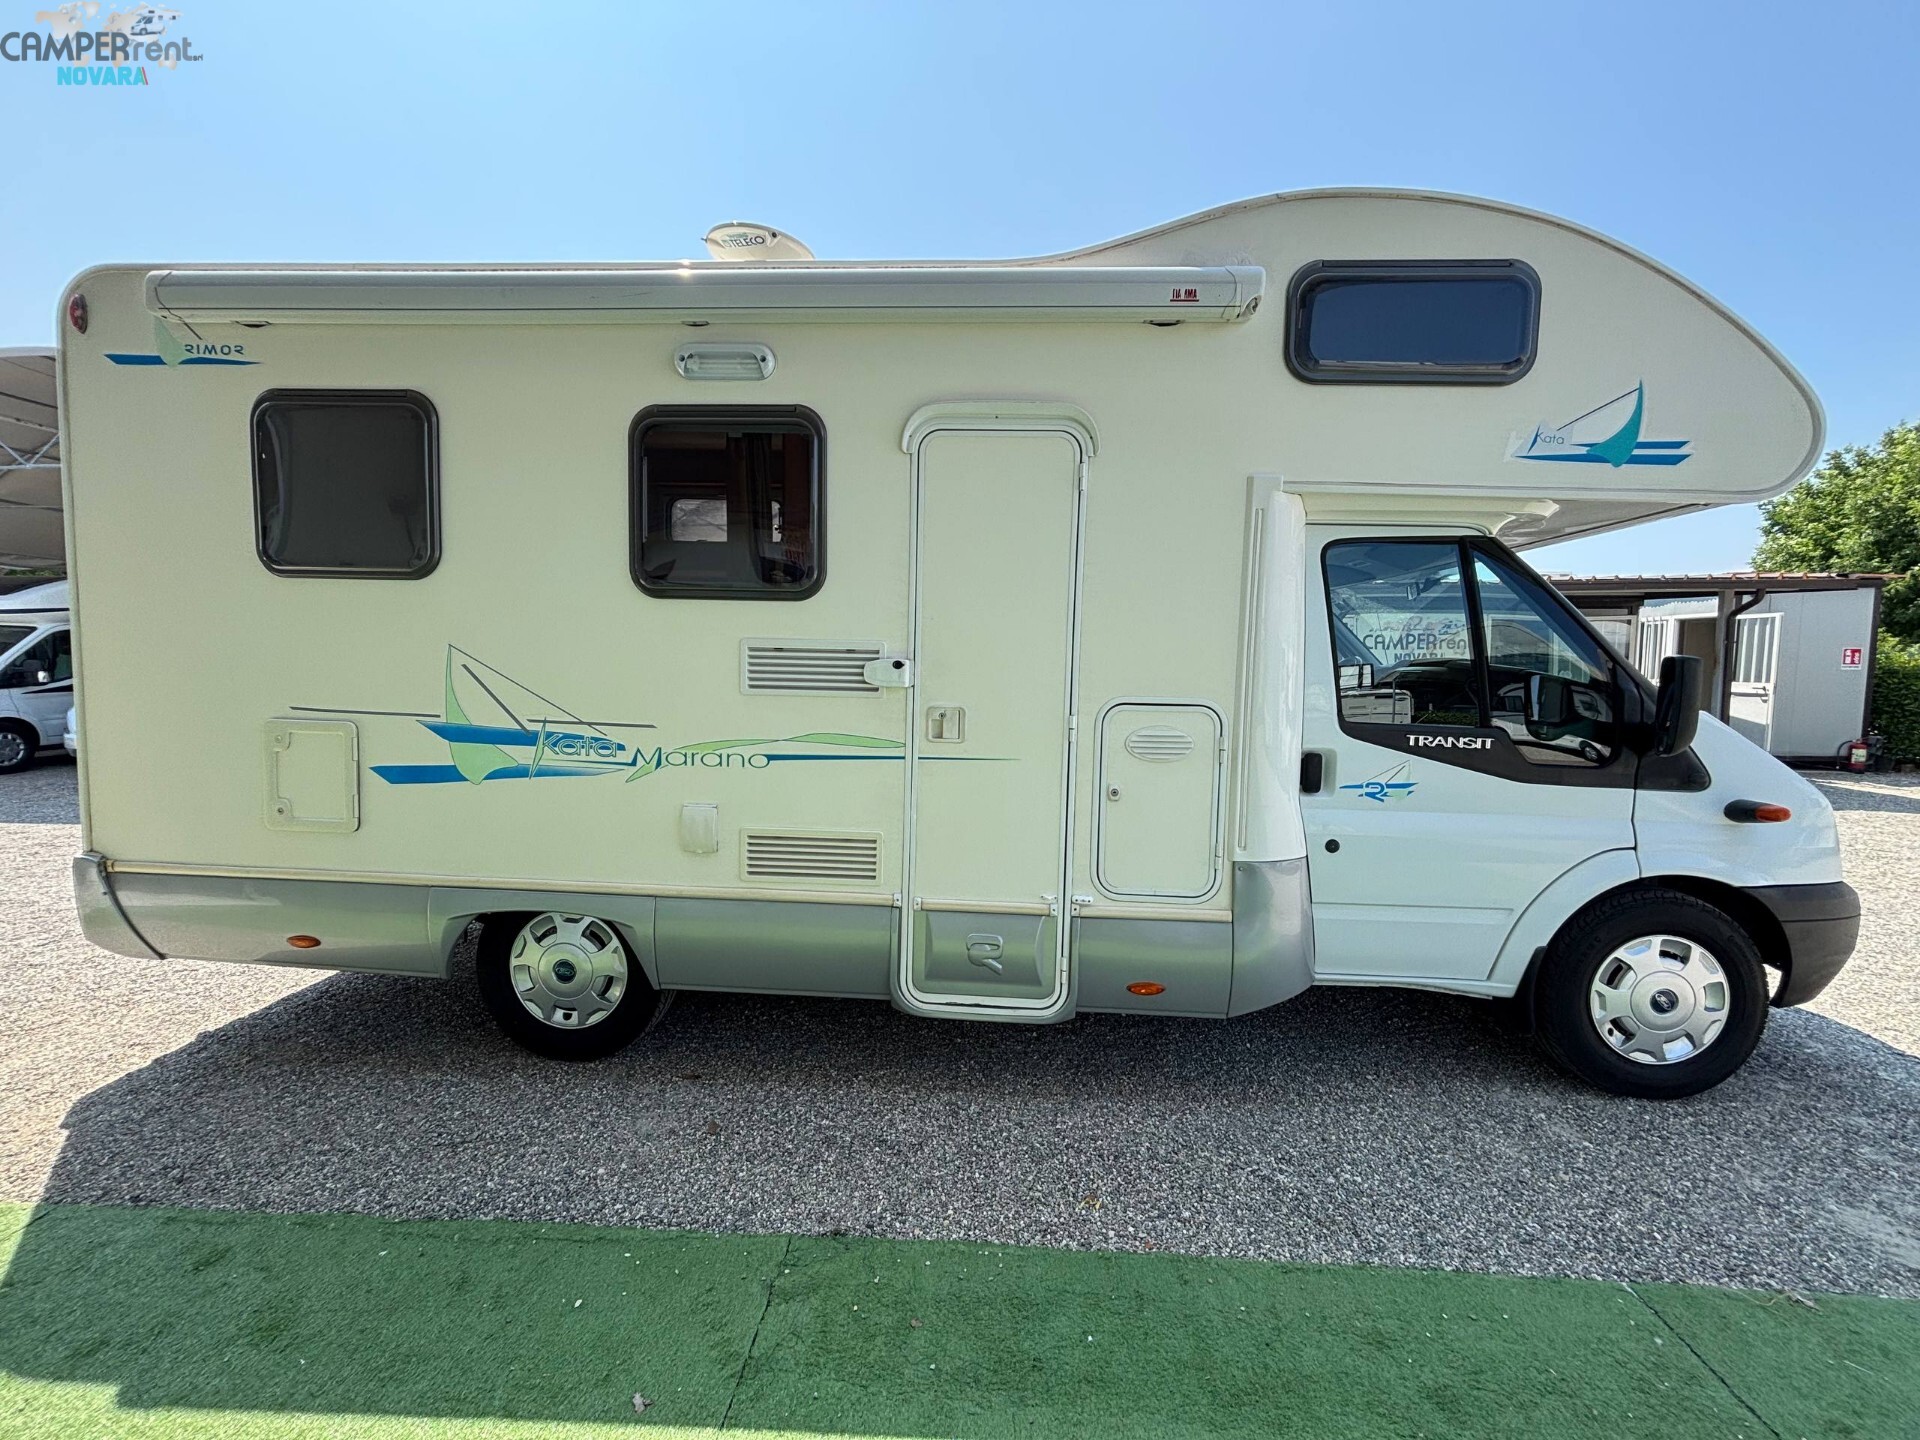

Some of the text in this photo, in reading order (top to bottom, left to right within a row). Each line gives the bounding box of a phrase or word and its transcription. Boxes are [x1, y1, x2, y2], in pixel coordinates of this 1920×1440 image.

[729, 235, 765, 248] TELECO
[184, 343, 245, 356] RIMOR
[1534, 427, 1566, 448] Kata
[1362, 633, 1468, 650] CAMPERren
[537, 728, 770, 772] Kata Marano
[1406, 734, 1495, 750] TRANSIT
